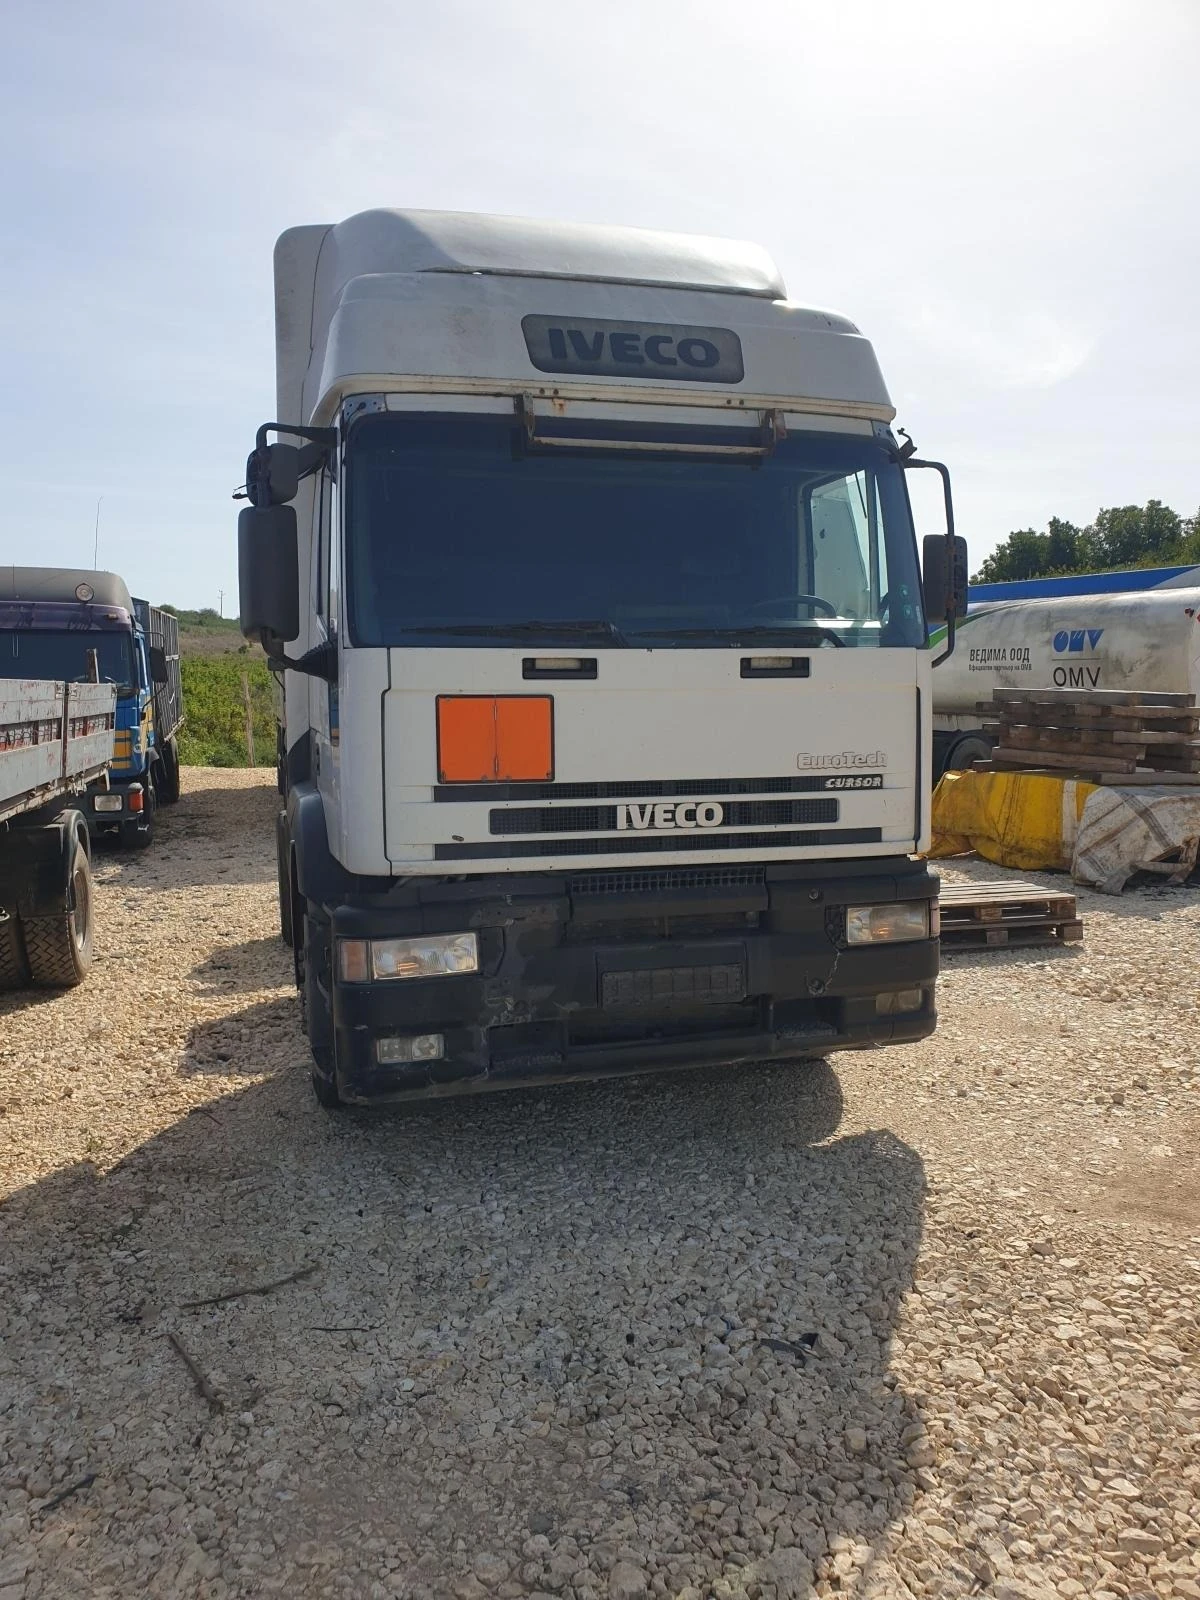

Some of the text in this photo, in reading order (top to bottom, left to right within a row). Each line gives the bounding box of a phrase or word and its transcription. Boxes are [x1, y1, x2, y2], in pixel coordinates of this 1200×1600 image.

[548, 328, 720, 368] IVECO
[1053, 628, 1105, 653] OMV
[969, 647, 1030, 663] ВЕДИМА ООД
[1053, 666, 1101, 687] OMV
[797, 751, 887, 770] EuroTech
[825, 777, 882, 788] CURSOR
[616, 802, 724, 830] IVECO
